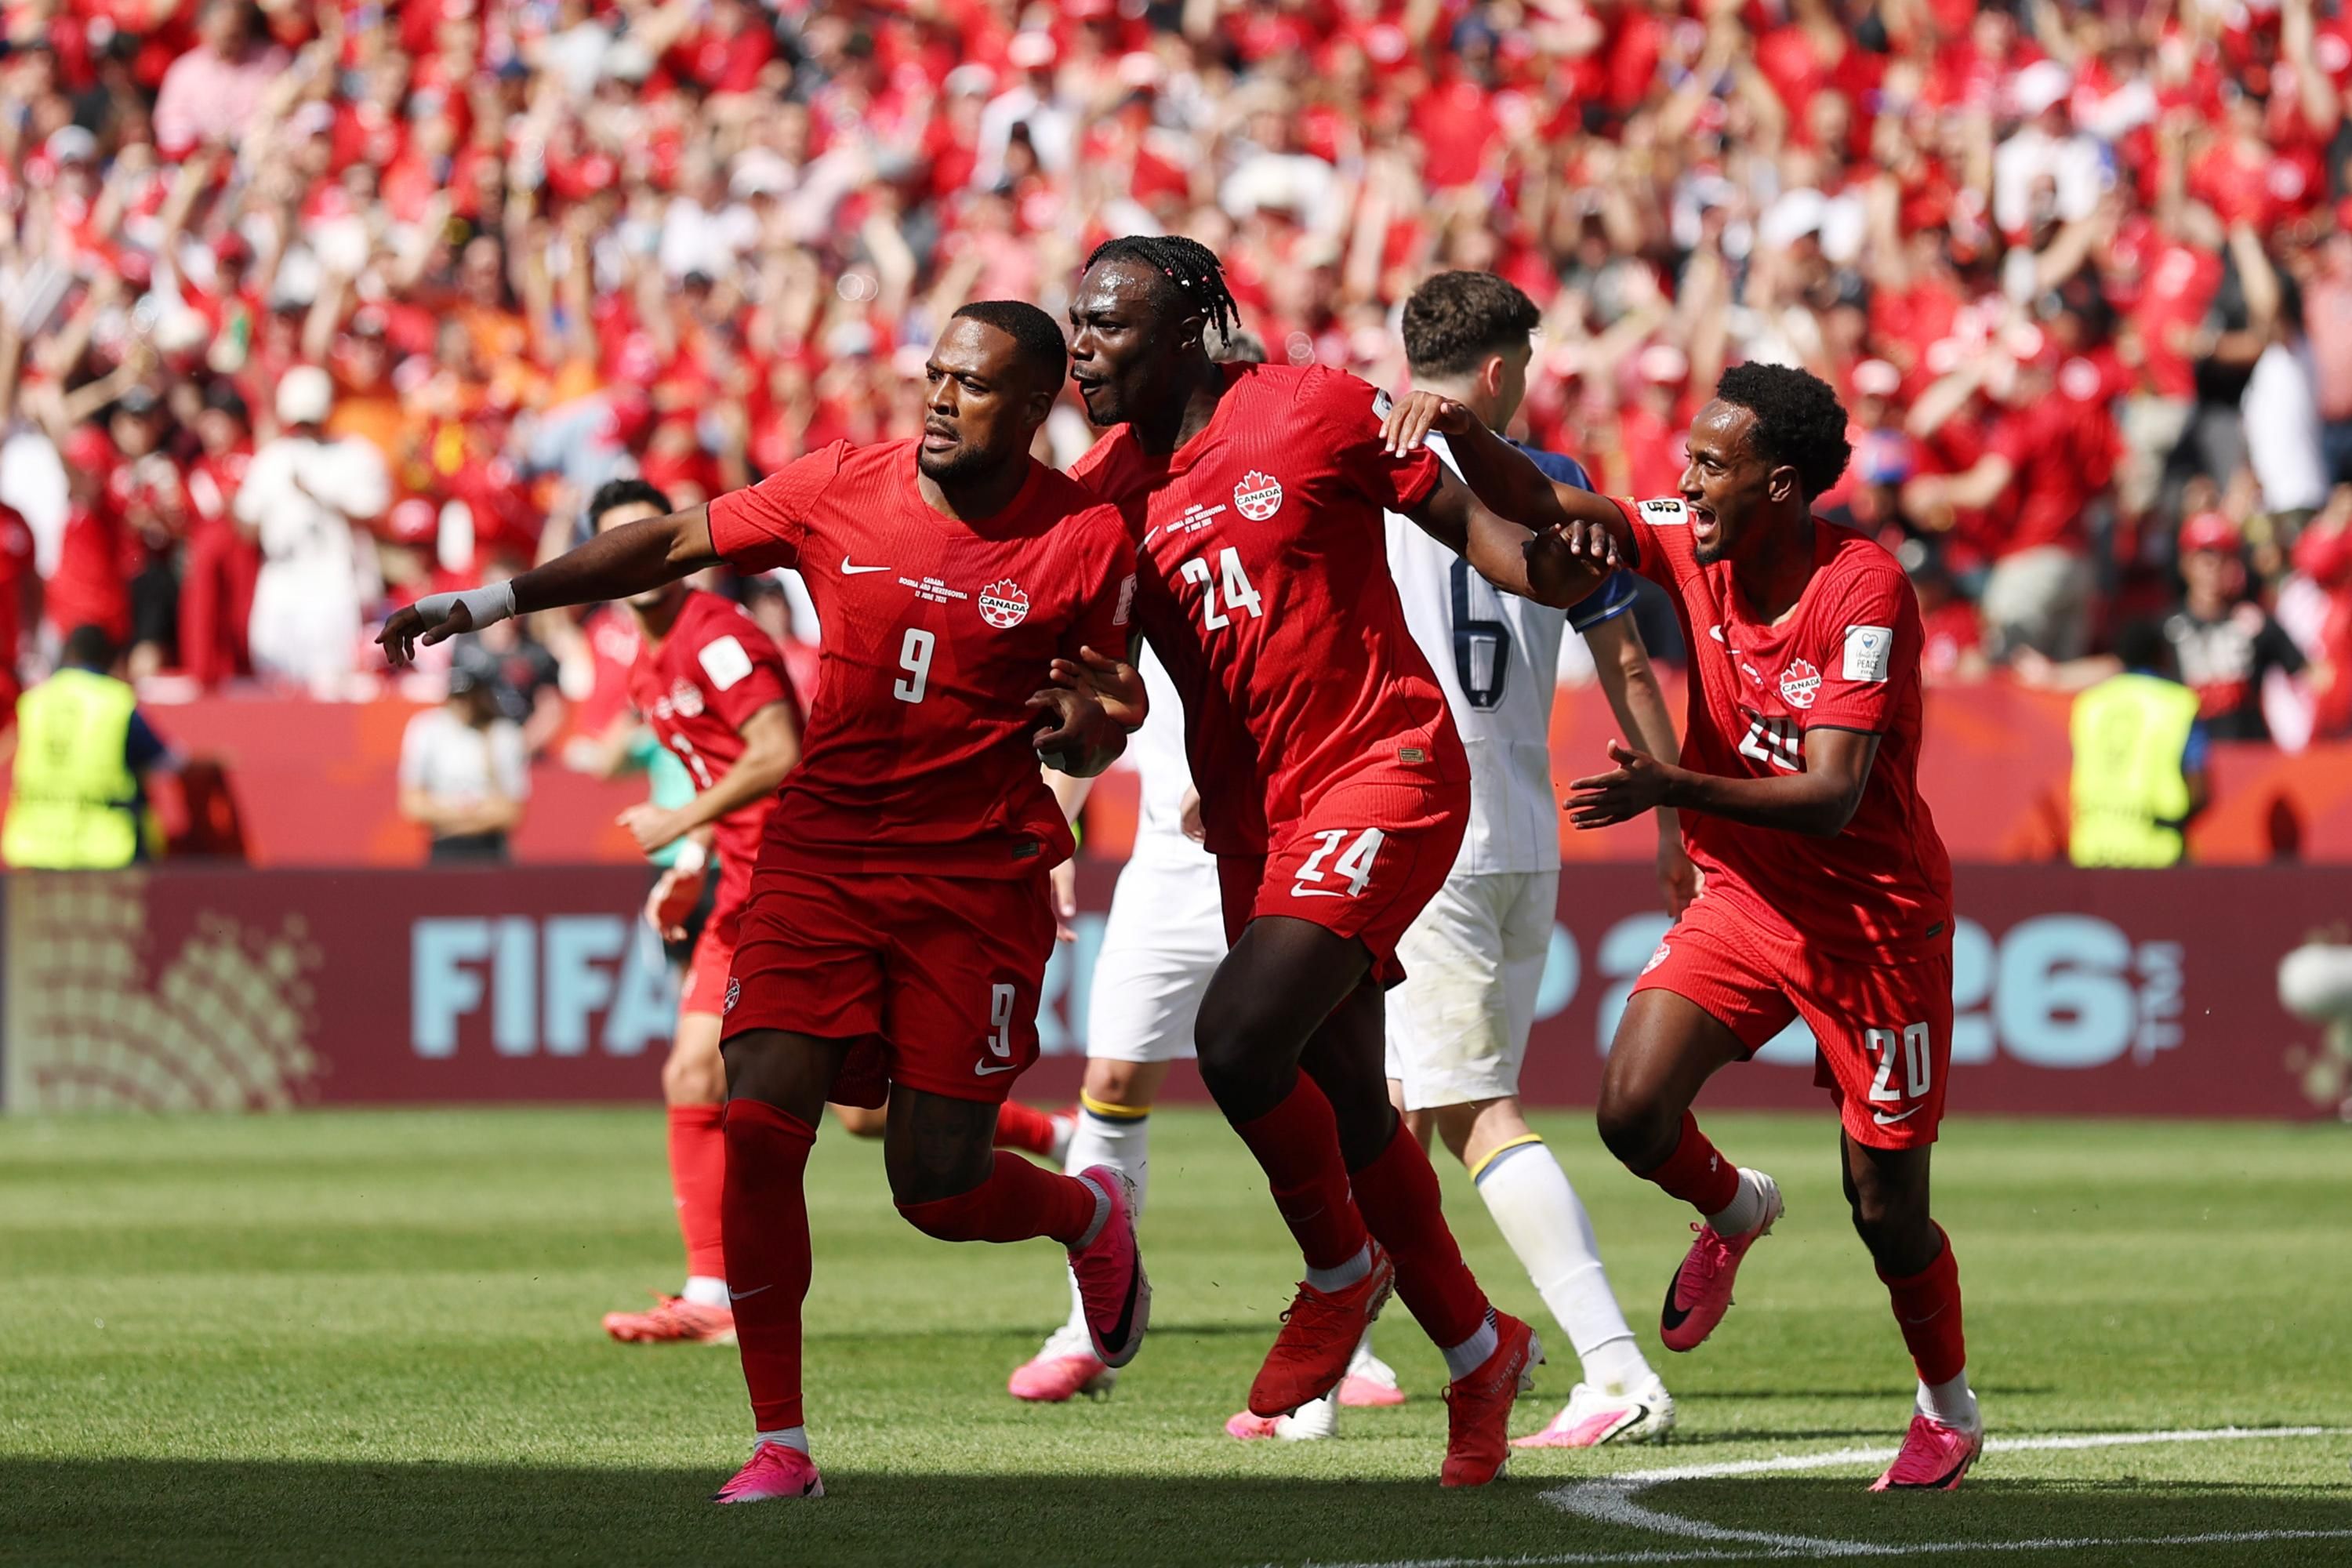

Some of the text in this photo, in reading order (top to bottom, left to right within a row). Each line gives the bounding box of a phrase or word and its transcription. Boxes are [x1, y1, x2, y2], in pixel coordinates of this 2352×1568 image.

[1236, 488, 1280, 506] CANADA
[980, 597, 1026, 612] CANADA
[1180, 546, 1262, 631] 24
[894, 627, 935, 703] 9
[1450, 556, 1513, 710] 6
[1857, 659, 1879, 670] PEACE
[1782, 677, 1821, 693] CANADA
[1294, 827, 1385, 898] 24
[410, 913, 679, 1058] FIFA
[988, 983, 1015, 1057] 9
[1865, 1022, 1930, 1101] 20
